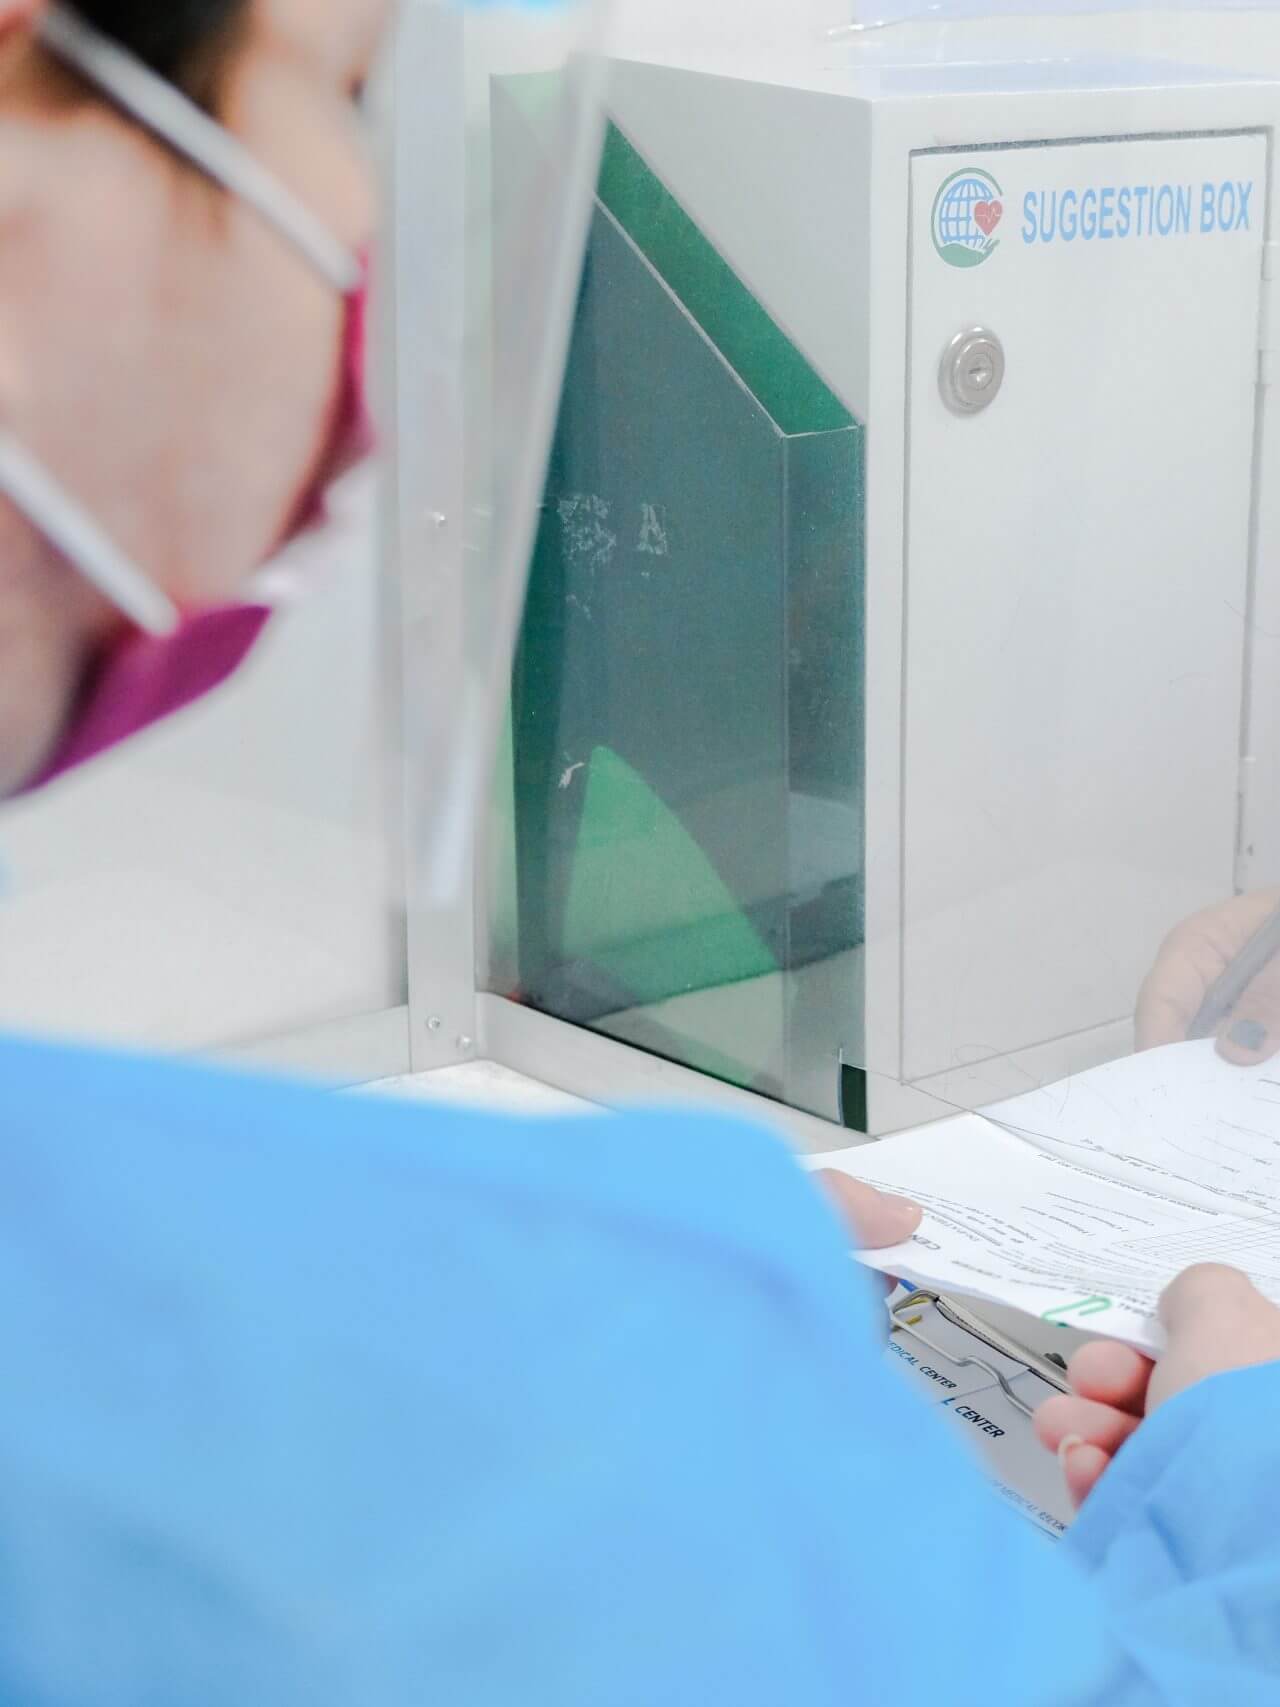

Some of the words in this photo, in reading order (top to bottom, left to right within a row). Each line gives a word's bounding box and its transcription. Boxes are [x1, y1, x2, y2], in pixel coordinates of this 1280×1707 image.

[1021, 184, 1192, 244] SUGGESTION
[1200, 181, 1253, 233] BOX
[888, 1342, 919, 1366] EDICAL
[919, 1366, 957, 1389] CENTER
[955, 1405, 1005, 1438] CENTER
